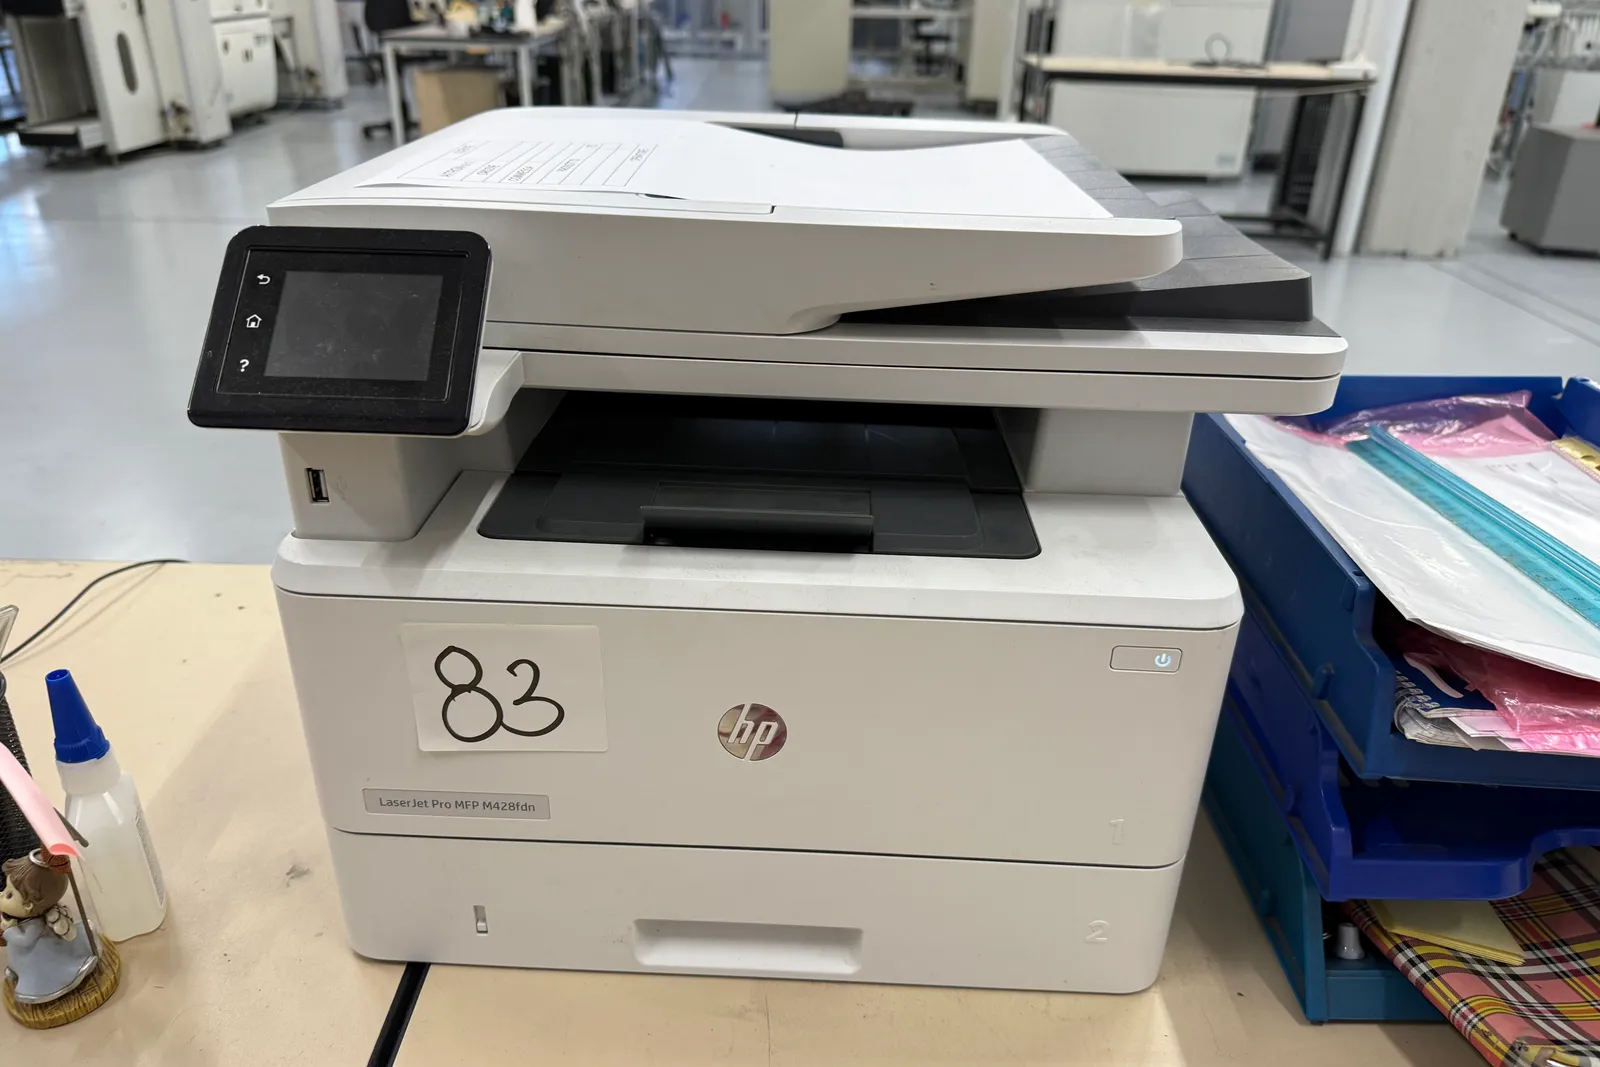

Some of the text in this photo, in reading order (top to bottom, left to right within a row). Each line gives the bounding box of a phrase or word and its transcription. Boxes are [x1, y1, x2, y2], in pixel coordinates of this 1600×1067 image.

[434, 645, 565, 743] 83
[724, 703, 781, 761] hp
[379, 797, 536, 812] LaserJet Pro MFP M428fdn
[1109, 817, 1125, 846] 1
[1085, 919, 1110, 943] 2
